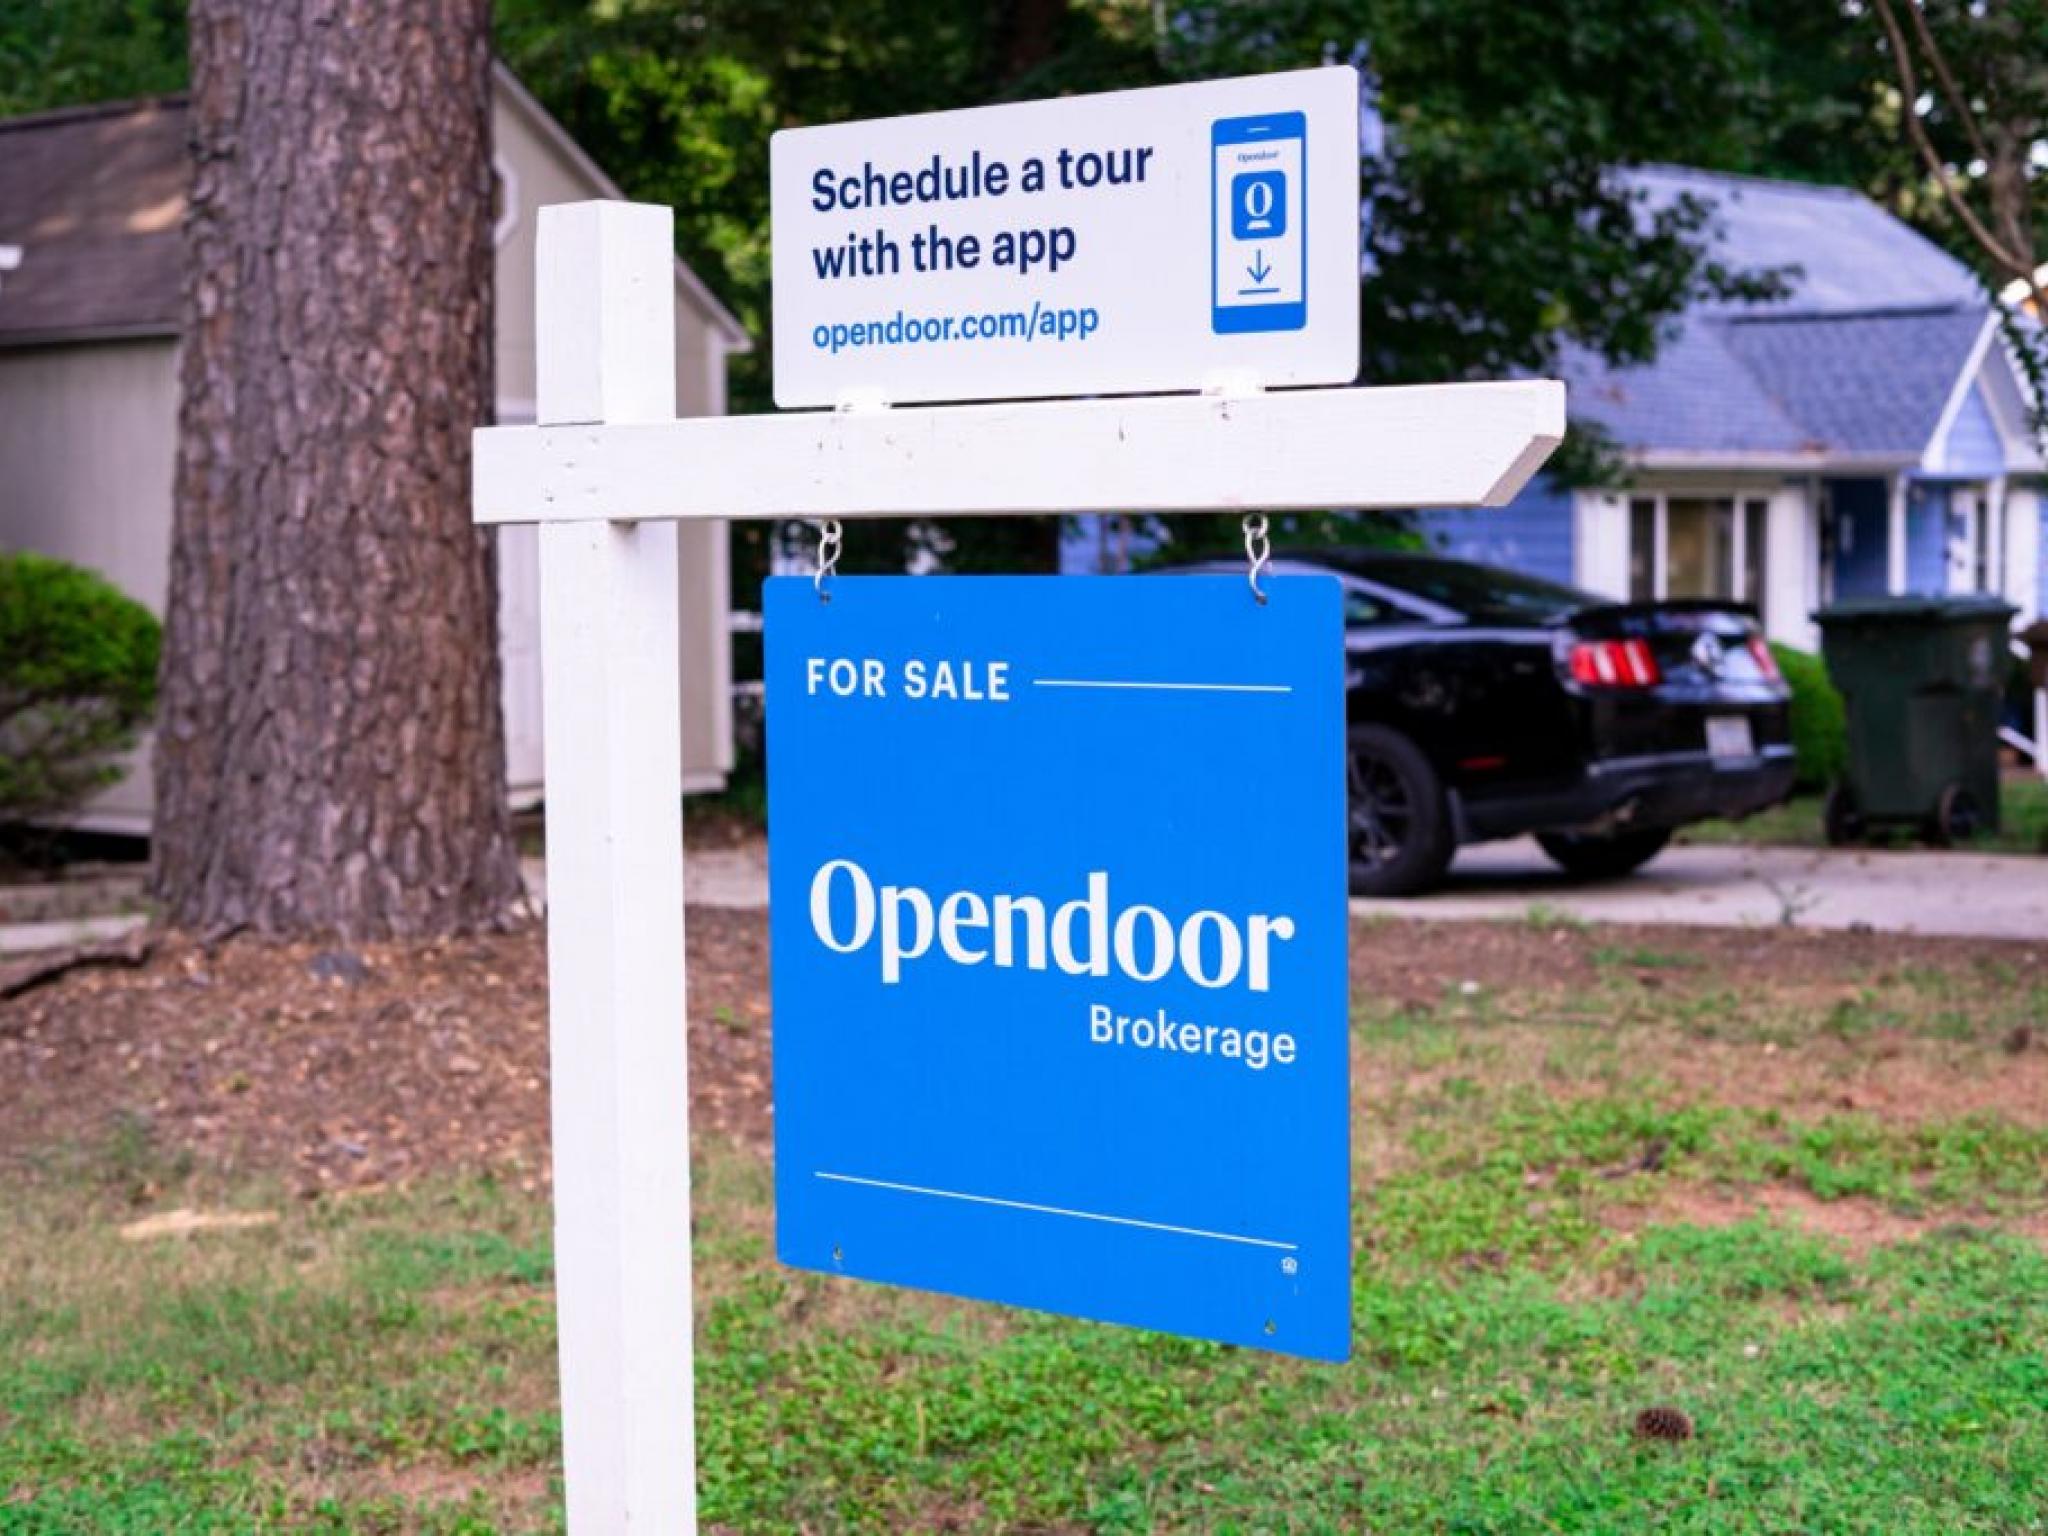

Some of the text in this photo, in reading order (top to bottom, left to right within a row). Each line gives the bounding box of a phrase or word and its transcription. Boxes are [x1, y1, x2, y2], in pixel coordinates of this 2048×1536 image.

[812, 146, 1154, 213] Schedule a tour
[812, 224, 1077, 280] with the app
[812, 301, 1100, 354] opendoor.com/app
[807, 658, 1010, 701] FOR SALE
[810, 858, 1295, 993] Opendoor
[1091, 1004, 1296, 1069] Brokerage
